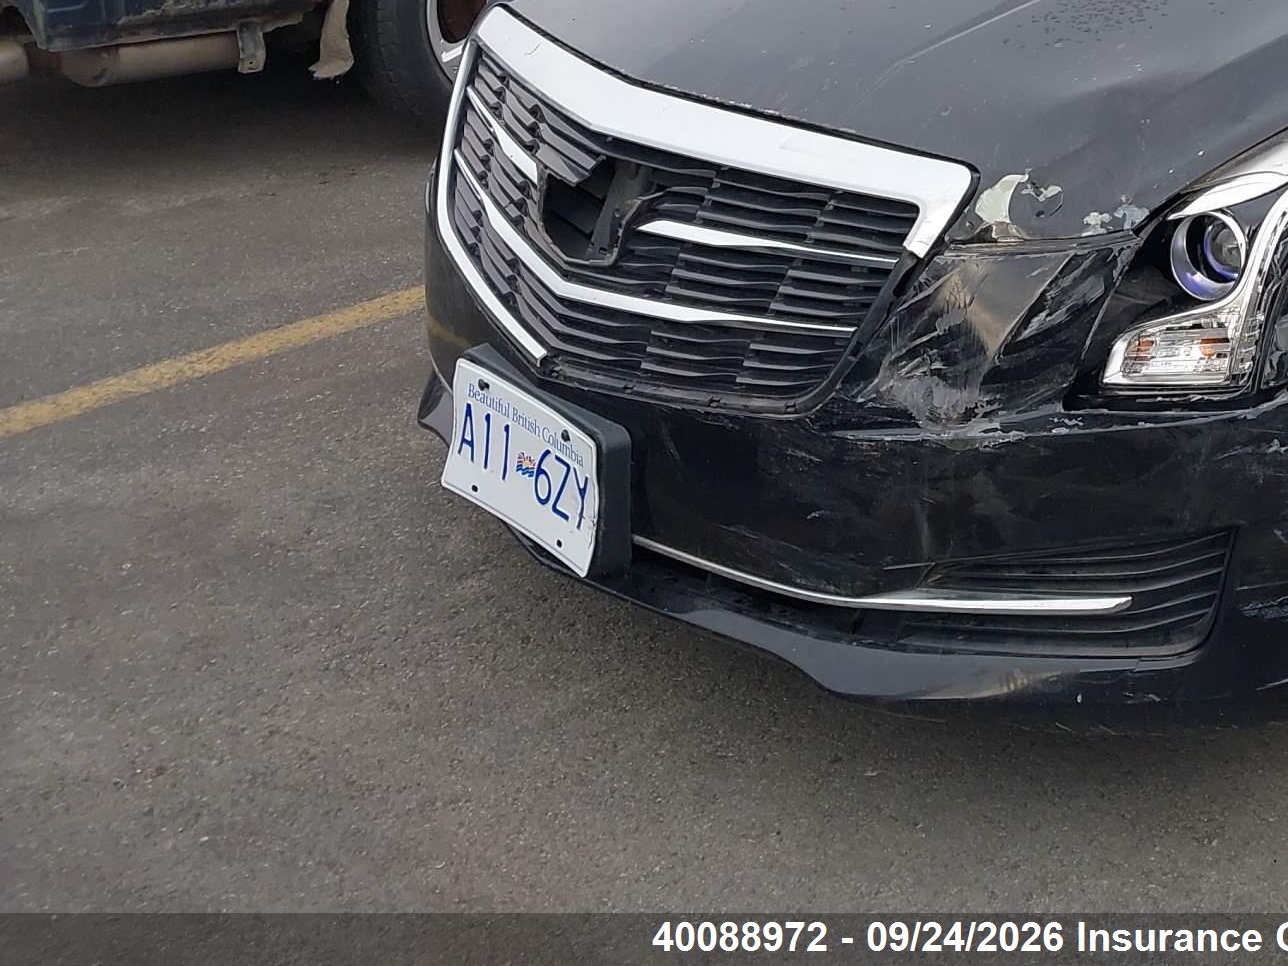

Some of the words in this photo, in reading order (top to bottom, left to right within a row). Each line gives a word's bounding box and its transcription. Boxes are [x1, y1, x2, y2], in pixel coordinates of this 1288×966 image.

[467, 382, 510, 419] Beautiful
[511, 406, 541, 439] British
[542, 424, 585, 467] Columbia
[533, 448, 589, 531] 6ZY
